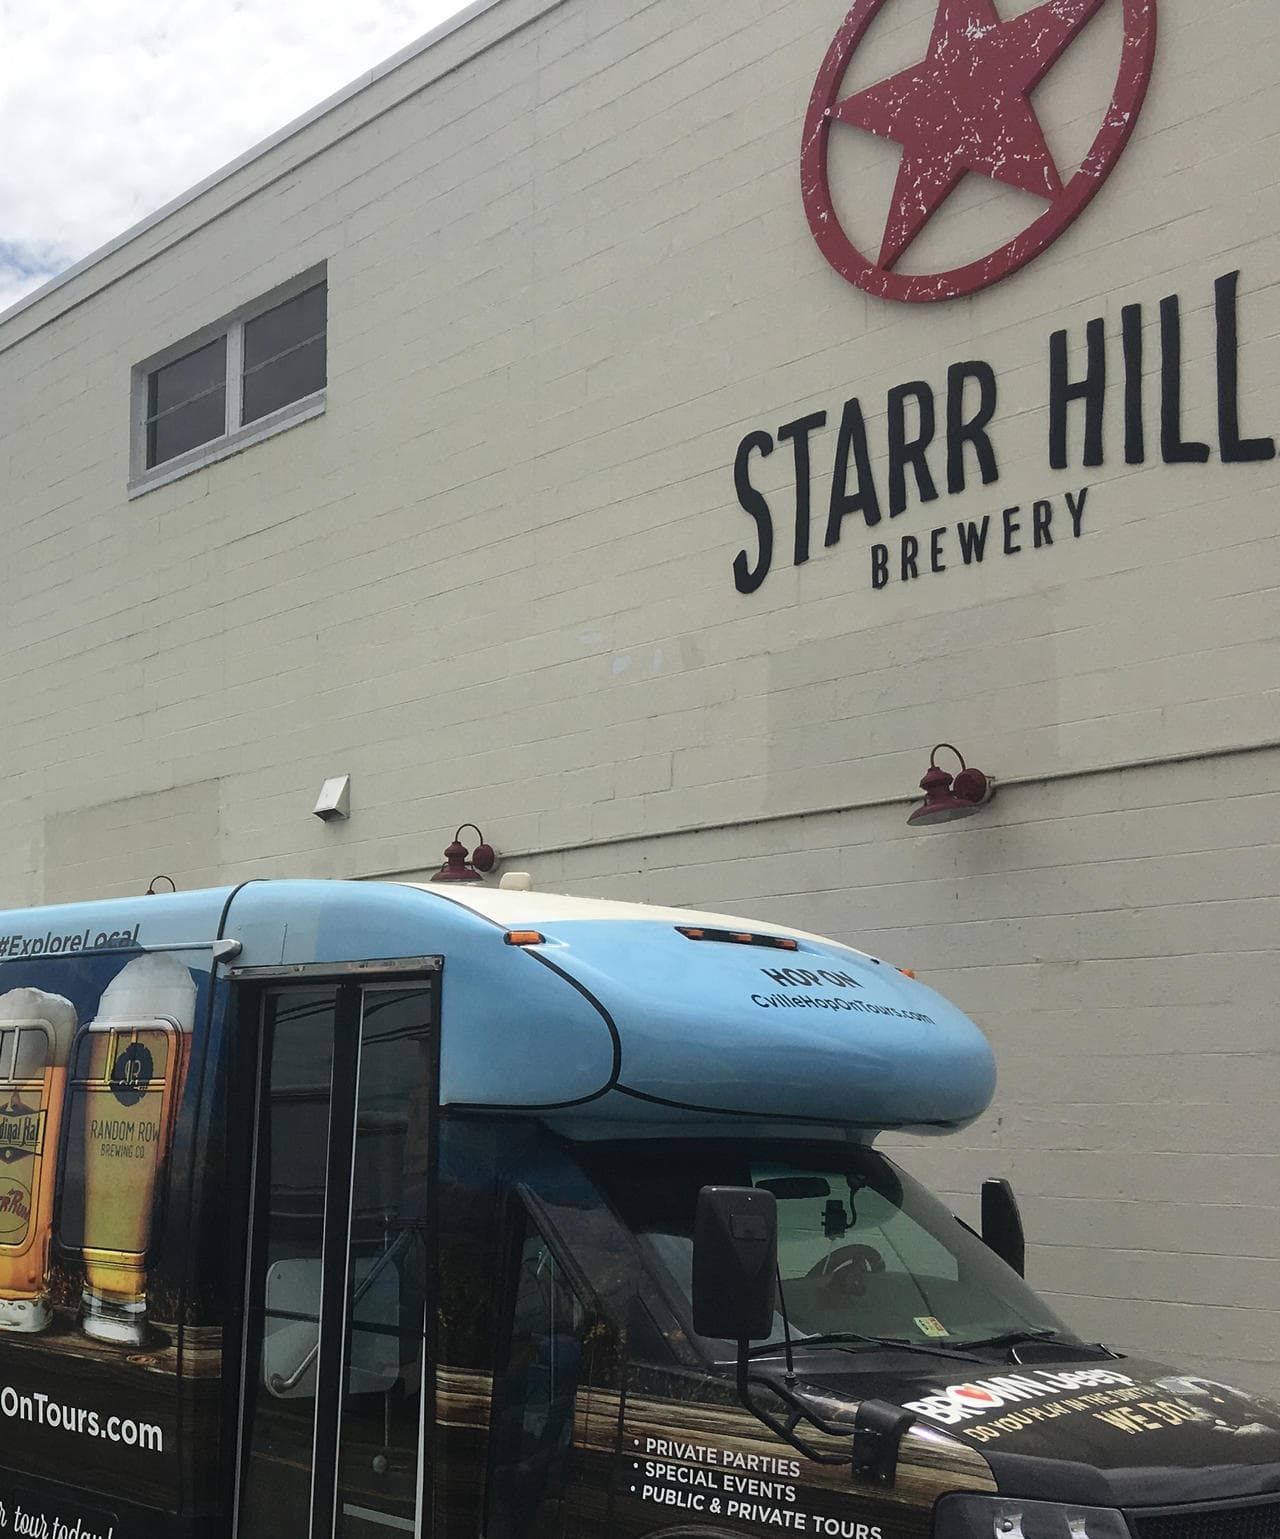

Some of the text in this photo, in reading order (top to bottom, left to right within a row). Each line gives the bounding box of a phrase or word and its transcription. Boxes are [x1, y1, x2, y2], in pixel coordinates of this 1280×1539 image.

[733, 270, 1276, 594] STARR HILL
[871, 488, 1088, 589] BREWERY
[760, 968, 865, 988] HOP ON
[751, 994, 935, 1025] CvilleHopOnTours.com
[91, 1120, 160, 1142] RANDOM ROW
[101, 1144, 133, 1159] BREWING
[1033, 1368, 1136, 1391] Jeep
[963, 1423, 1001, 1443] DO
[988, 1411, 1036, 1433] YOU
[1023, 1402, 1072, 1421] PLAY
[1061, 1399, 1090, 1412] IN
[1078, 1393, 1120, 1406] THE
[1092, 1406, 1163, 1435] WE
[646, 1437, 801, 1478] PRIVATE PARTIES
[645, 1461, 797, 1502] SPECIAL EVENTS
[14, 1506, 48, 1539] tour
[642, 1485, 882, 1539] PUBLIC & PRIVATE TOURS
